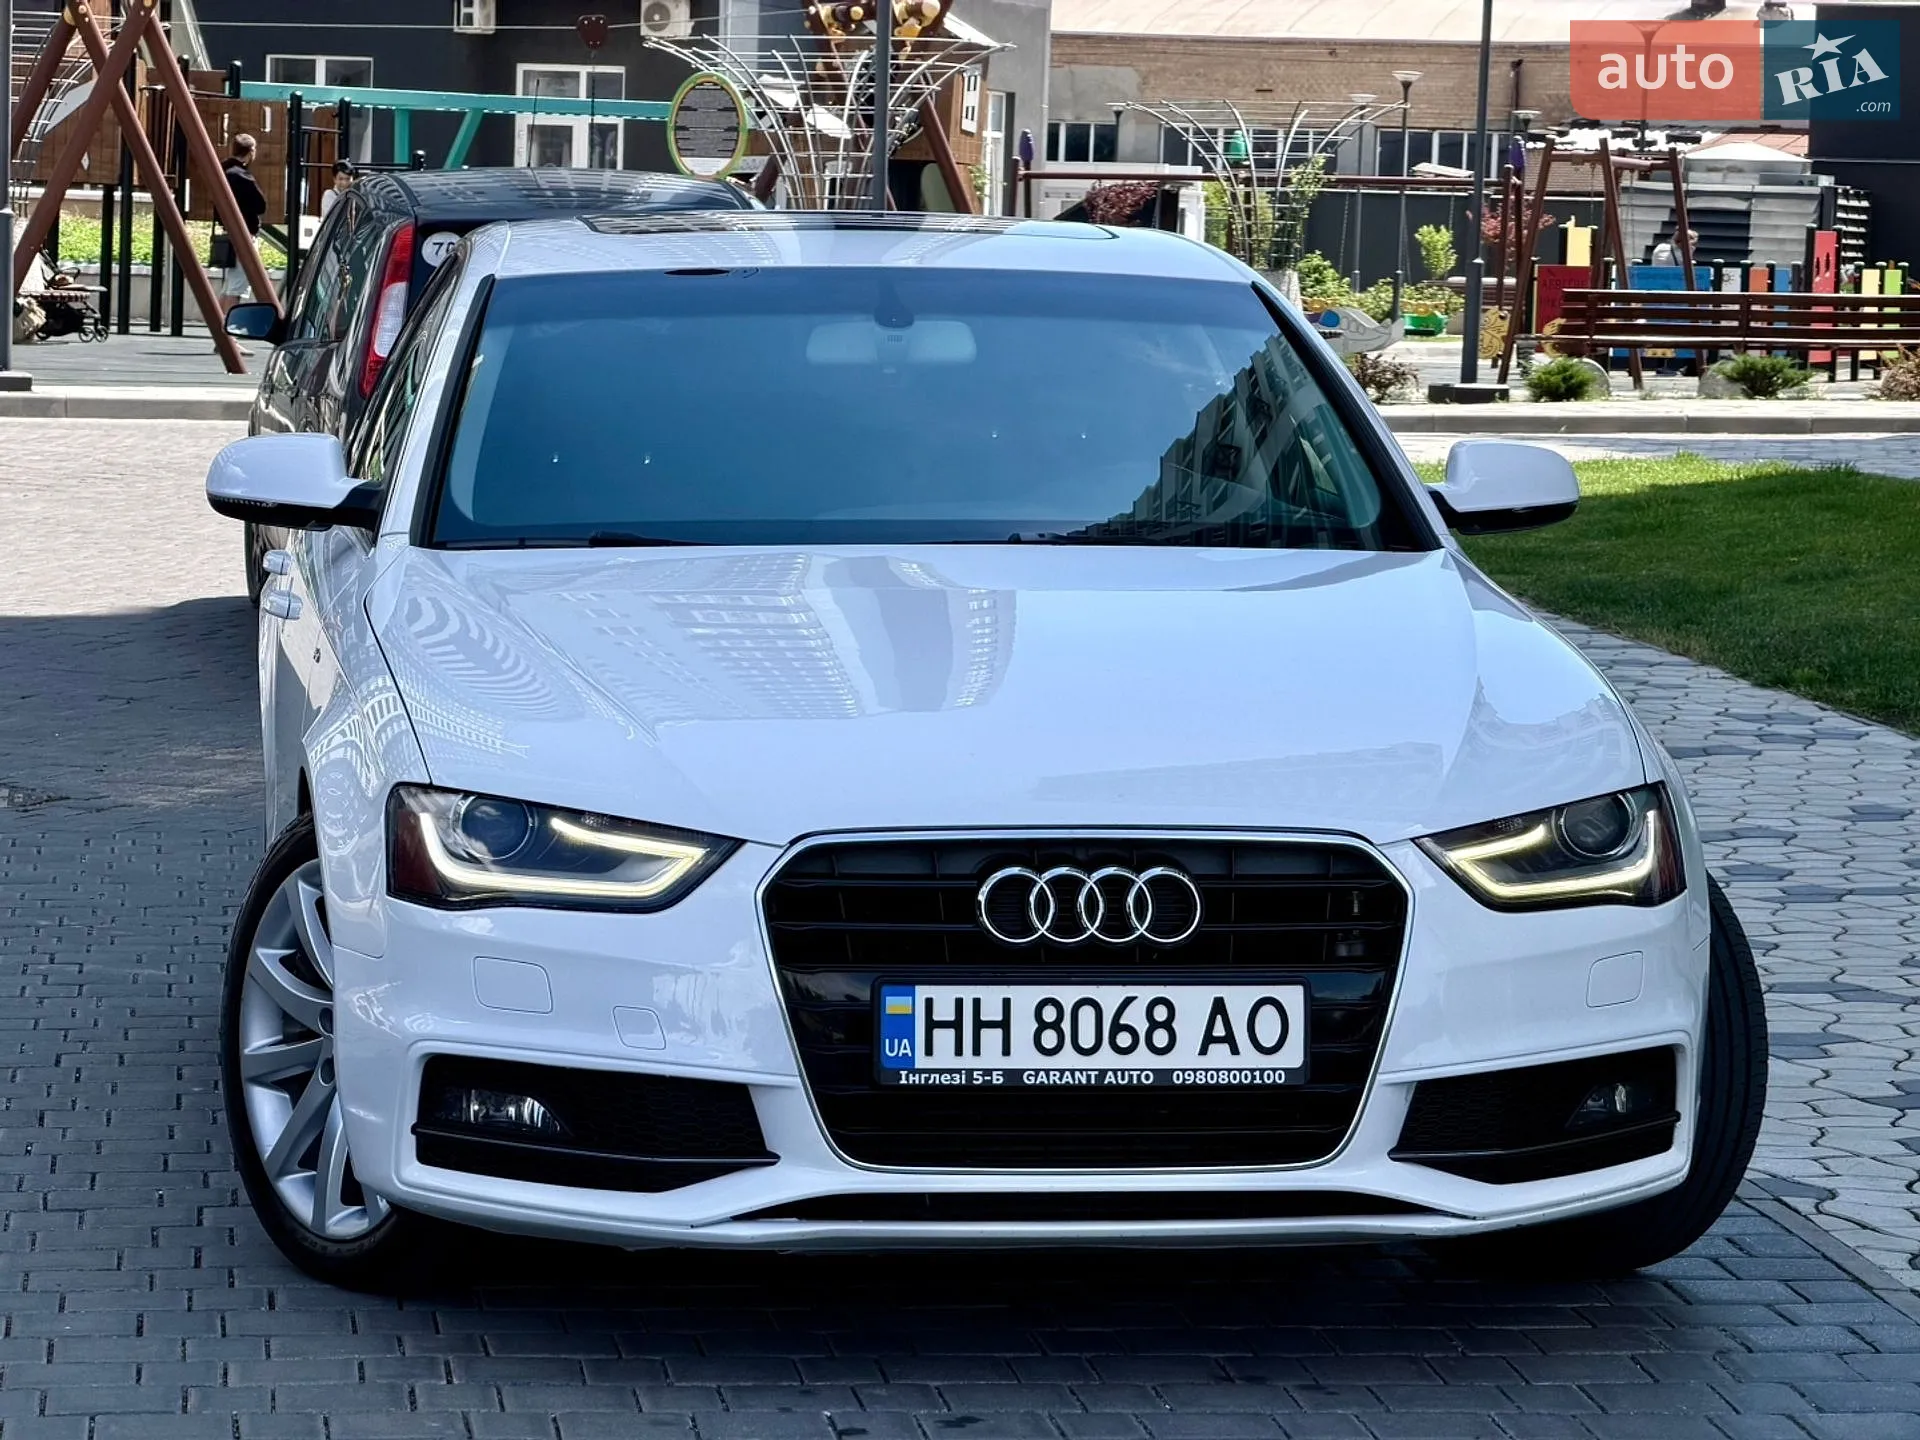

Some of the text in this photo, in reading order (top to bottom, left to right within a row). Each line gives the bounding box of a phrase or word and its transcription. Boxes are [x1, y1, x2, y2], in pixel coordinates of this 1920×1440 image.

[924, 996, 1290, 1057] HH 8068 AO
[885, 1038, 912, 1057] UA
[900, 1070, 1004, 1085] Інглезі 5-Б
[1023, 1071, 1154, 1085] GARANT AUTO
[1172, 1070, 1286, 1085] 0980800100
